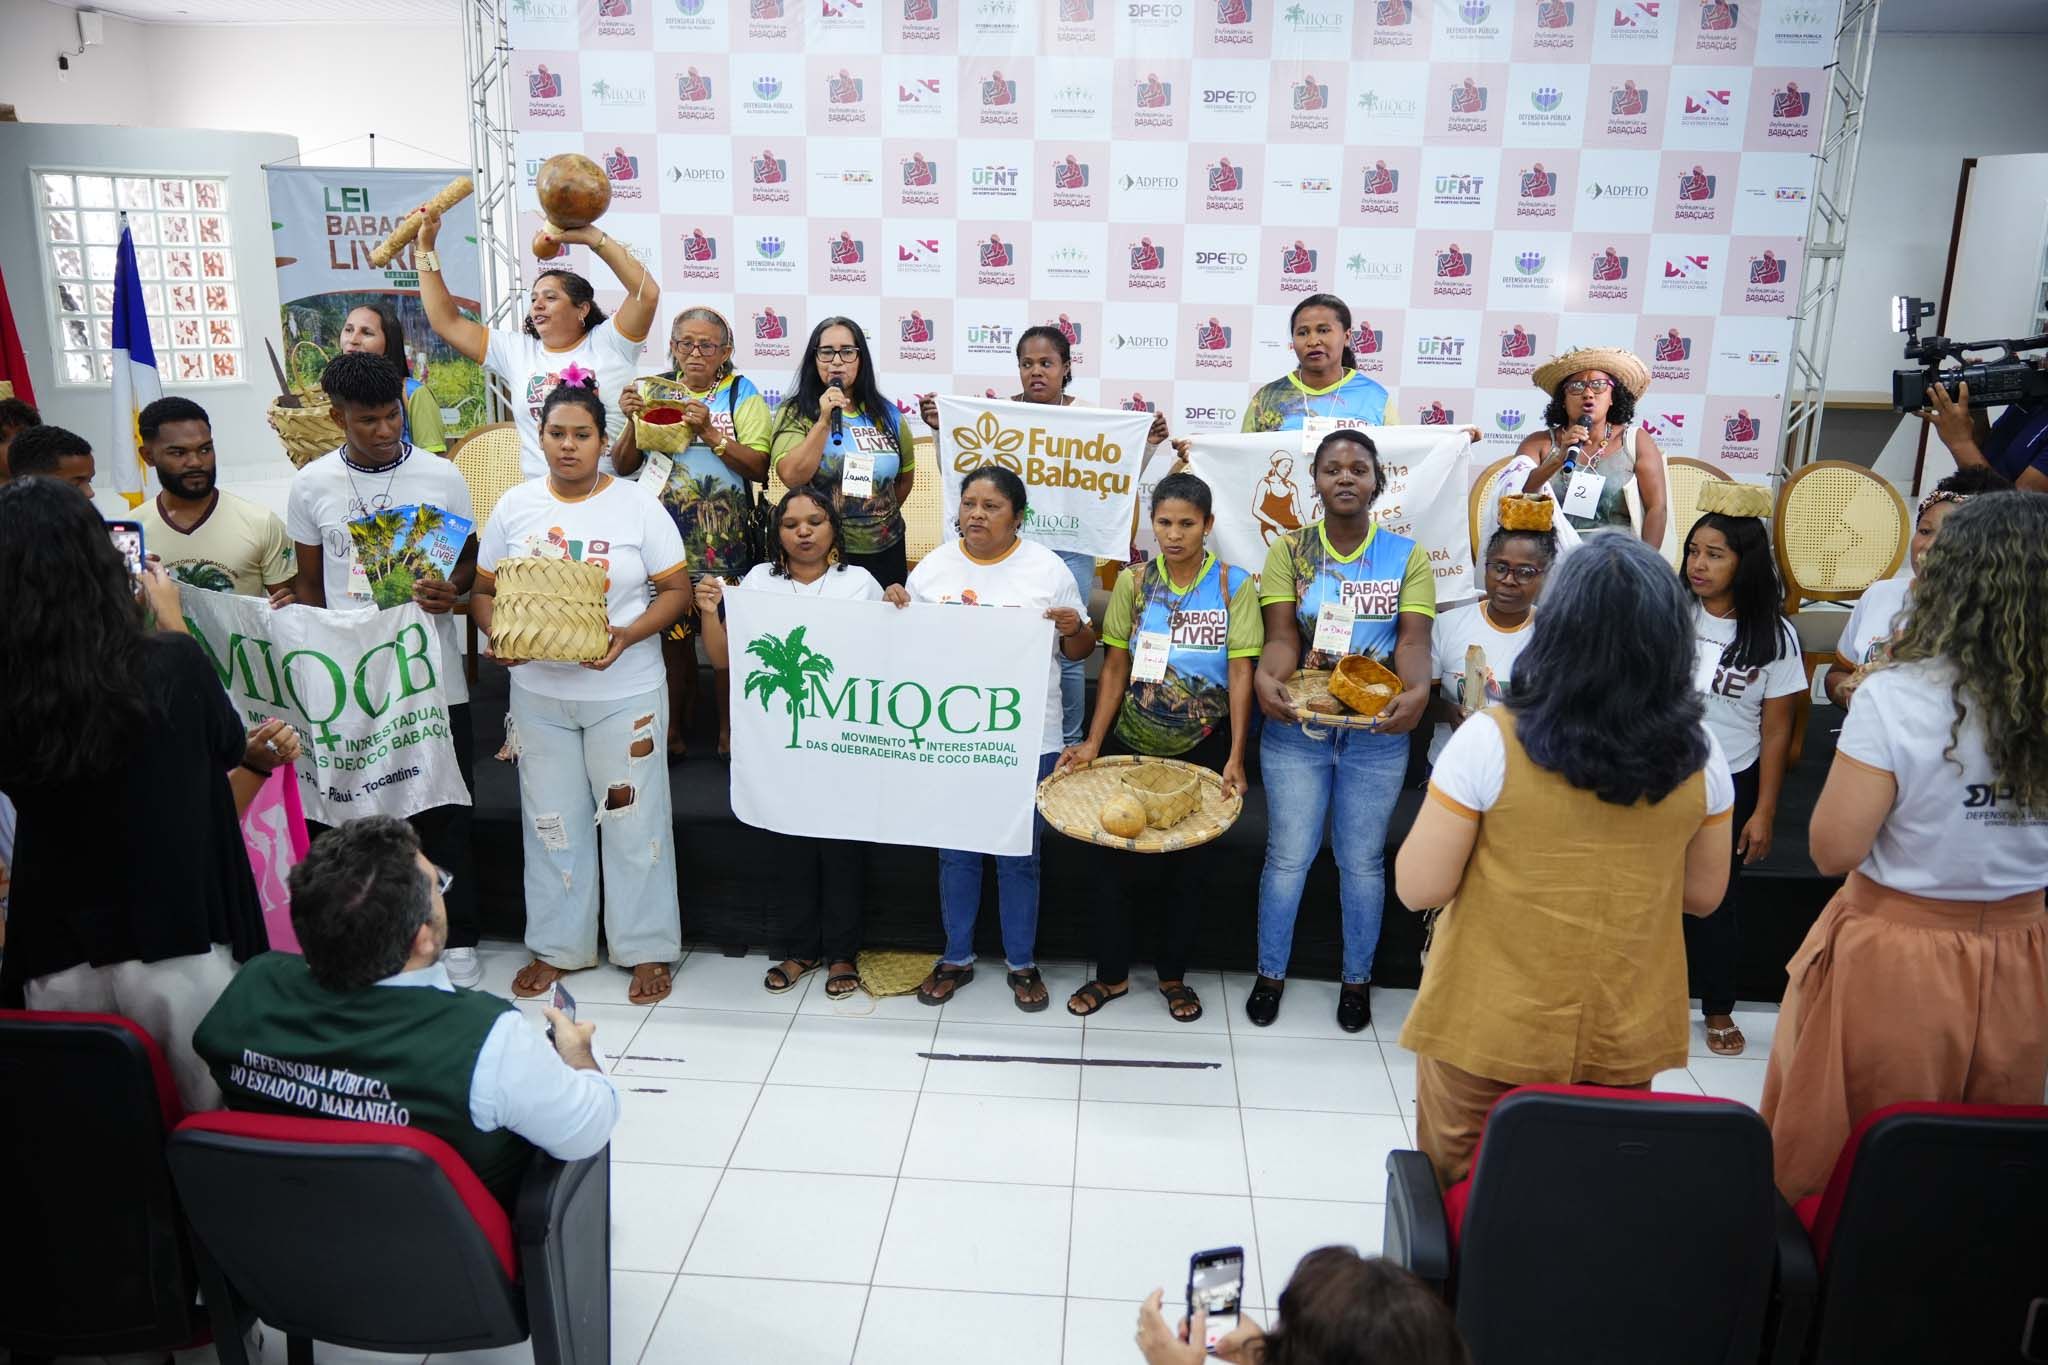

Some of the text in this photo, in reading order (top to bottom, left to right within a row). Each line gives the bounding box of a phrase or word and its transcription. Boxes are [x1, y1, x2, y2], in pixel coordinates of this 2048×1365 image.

[1298, 14, 1342, 28] MIQCB
[902, 32, 940, 40] BABAÇUAIS
[1215, 36, 1253, 44] BABAÇUAIS
[1534, 40, 1573, 48] BABAÇUAIS
[1696, 41, 1736, 50] BABAÇUAIS
[530, 109, 566, 118] BABAÇUAIS
[679, 112, 714, 120] BABAÇUAIS
[828, 114, 866, 122] BABAÇUAIS
[980, 116, 1018, 125] BABAÇUAIS
[1135, 118, 1172, 127] BABAÇUAIS
[1290, 121, 1328, 130] BABAÇUAIS
[1448, 124, 1487, 132] BABAÇUAIS
[1608, 126, 1646, 135] BABAÇUAIS
[1768, 129, 1808, 138] BABAÇUAIS
[685, 168, 725, 179] ADPETO
[972, 172, 1018, 186] UFNT
[1136, 176, 1178, 187] ADPETO
[1436, 180, 1484, 194] UFNT
[1604, 184, 1648, 197] ADPETO
[612, 190, 642, 200] BAÇUAIS
[753, 194, 789, 202] BABAÇUAIS
[324, 187, 370, 213] LEI
[902, 196, 939, 204] BABAÇUAIS
[1054, 199, 1090, 208] BABAÇUAIS
[1206, 202, 1244, 210] BABAÇUAIS
[1361, 205, 1399, 214] BABAÇUAIS
[1517, 208, 1556, 217] BABAÇUAIS
[1675, 210, 1714, 220] BABAÇUAIS
[326, 215, 405, 236] BABA
[683, 270, 719, 279] BABAÇUAIS
[830, 274, 866, 282] BABAÇUAIS
[979, 276, 1015, 285] BABAÇUAIS
[1129, 280, 1166, 288] BABAÇUAIS
[1280, 284, 1317, 292] BABAÇUAIS
[1434, 287, 1471, 296] BABAÇUAIS
[1589, 291, 1627, 300] BABAÇUAIS
[1746, 294, 1784, 303] BABAÇUAIS
[968, 331, 1012, 344] UFNT
[1127, 336, 1168, 346] ADPETO
[754, 348, 790, 357] BABAÇUAIS
[1418, 342, 1464, 355] UFNT
[900, 352, 936, 360] BABAÇUAIS
[1196, 360, 1232, 368] BABAÇUAIS
[1358, 363, 1384, 372] AÇUAIS
[1652, 372, 1690, 380] BABAÇUAIS
[1028, 428, 1121, 464] Fundo
[1721, 451, 1758, 460] BABAÇUAIS
[844, 472, 872, 483] Laura
[1026, 458, 1130, 500] Babaçu
[1574, 486, 1587, 499] 2
[1030, 514, 1079, 530] MIQCB
[436, 534, 448, 544] LEI
[431, 548, 455, 562] LIVRE
[1343, 582, 1400, 596] BABAÇU
[1171, 626, 1226, 646] LIVRE
[182, 616, 436, 742] MIQCB
[806, 673, 1022, 738] MIQCB
[841, 732, 1016, 753] MOVIMENTO INTERESTADUAL
[806, 740, 1018, 767] DAS QUEBRADEIRAS DE COCO BABAÇU
[362, 764, 420, 794] Tocantins
[244, 1048, 391, 1100] DEFENSORIA PÚBLICA
[230, 1064, 410, 1127] DO ESTADO DO MARANHÃO
